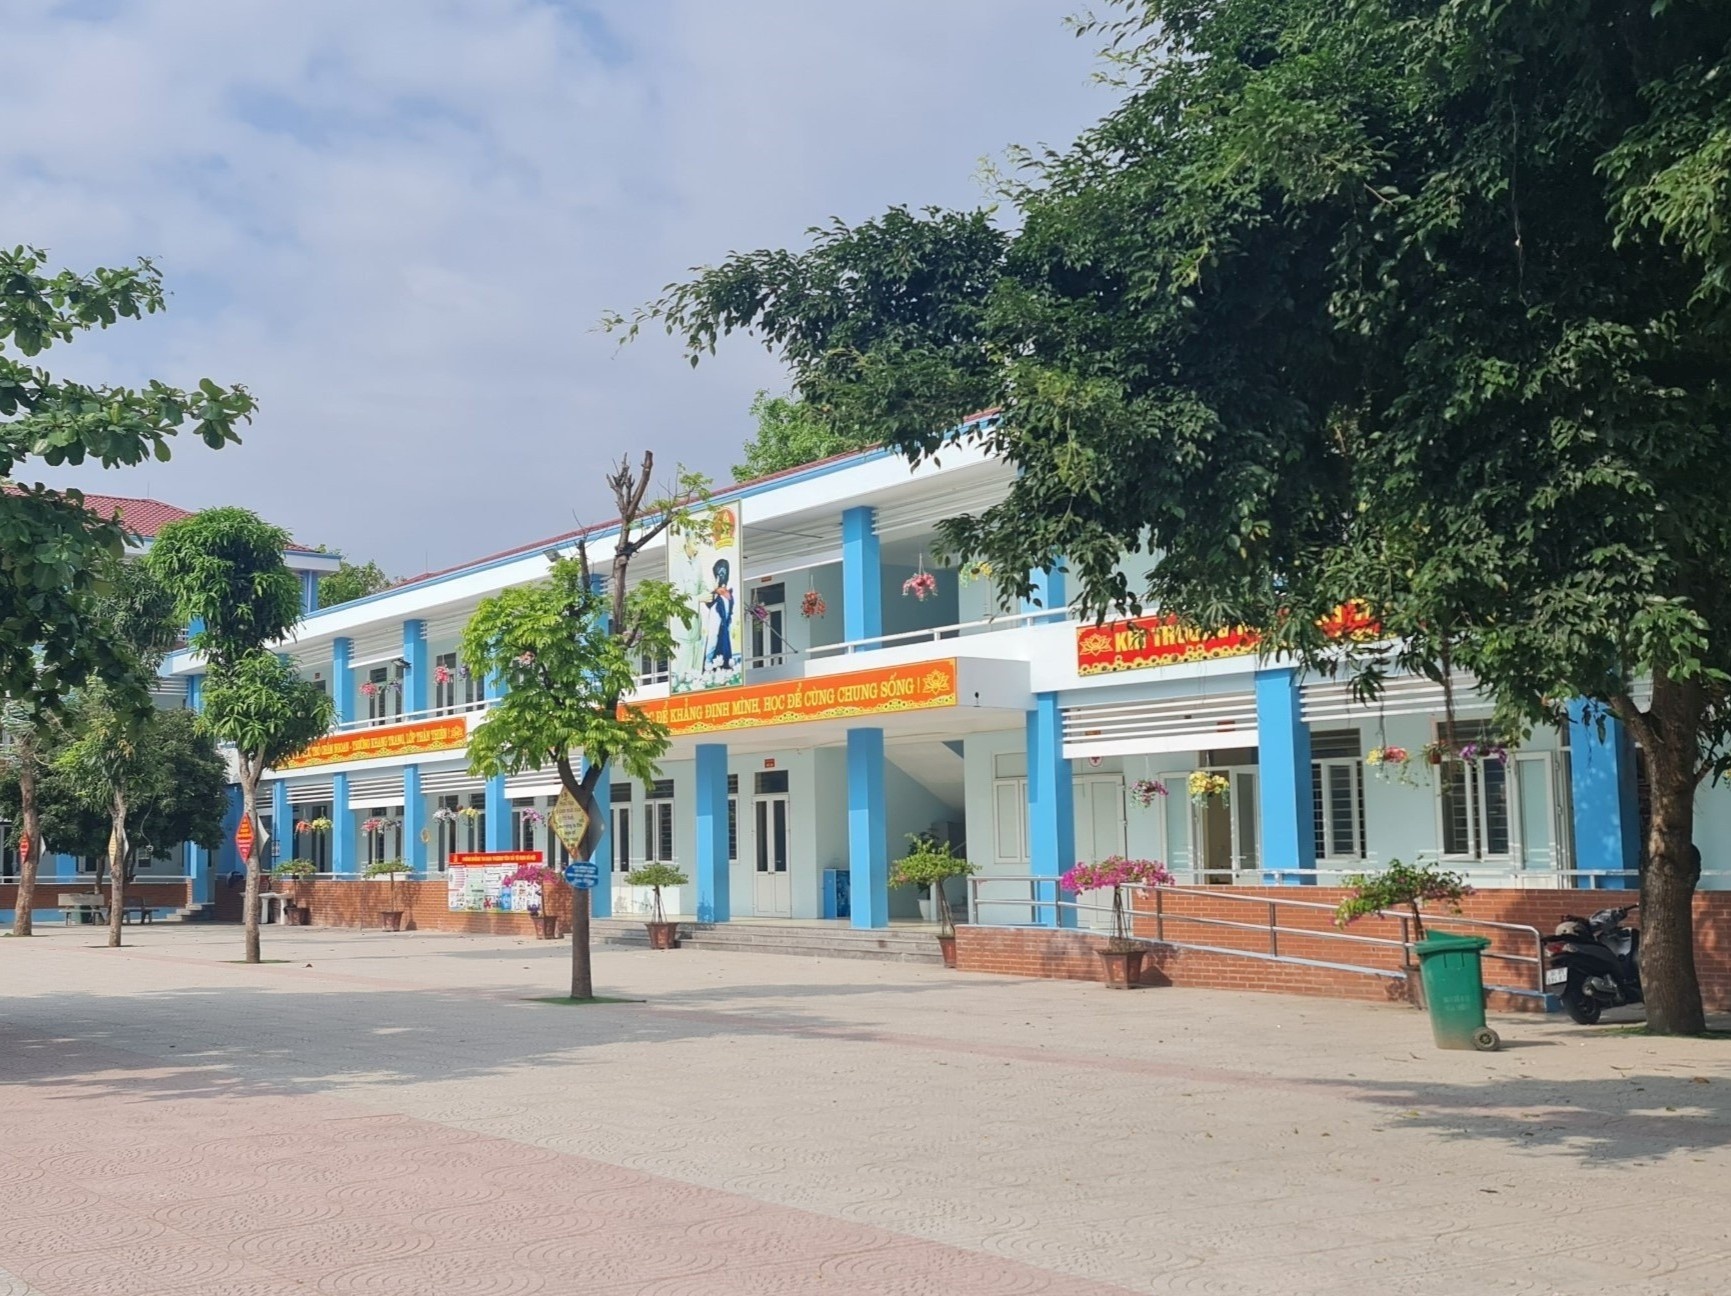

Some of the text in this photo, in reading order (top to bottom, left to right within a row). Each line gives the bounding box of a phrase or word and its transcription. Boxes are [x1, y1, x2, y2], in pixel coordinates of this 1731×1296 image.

[656, 701, 669, 723] ĐỂ
[705, 701, 730, 722] ĐỊNH
[732, 695, 761, 715] MÌNH,
[764, 694, 785, 715] HỌC
[787, 682, 803, 709] ĐỂ
[805, 686, 835, 706] CÙNG
[837, 683, 878, 702] CHUNG
[880, 672, 914, 698] SỐNG
